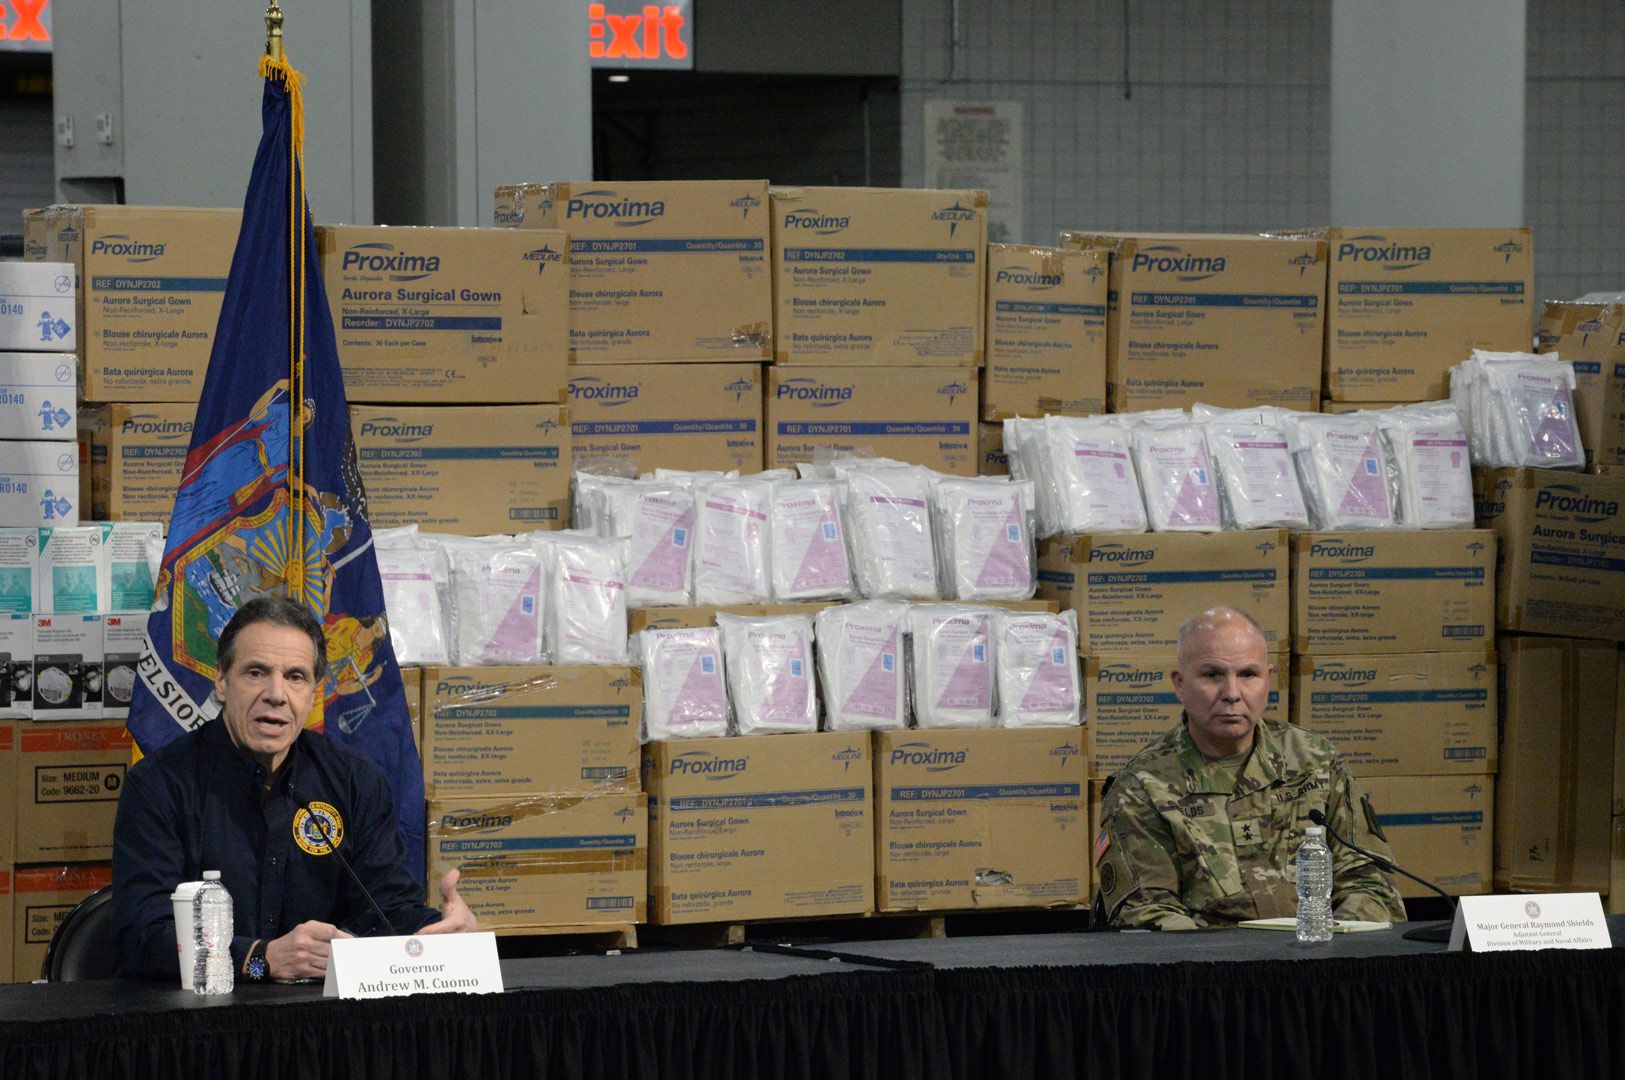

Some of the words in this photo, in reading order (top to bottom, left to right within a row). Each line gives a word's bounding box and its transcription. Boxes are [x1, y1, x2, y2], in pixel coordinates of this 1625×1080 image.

[567, 199, 665, 218] Proxima
[785, 215, 849, 229] Proxima
[92, 238, 165, 257] Proxima
[1338, 243, 1432, 261] Proxima
[342, 252, 440, 272] Proxima
[522, 253, 562, 262] MEDLINE
[593, 257, 624, 267] Surgical
[1132, 253, 1226, 272] Proxima
[793, 267, 817, 275] Aurora
[997, 271, 1062, 285] Proxima
[342, 288, 392, 301] Aurora
[397, 289, 456, 303] Surgical
[460, 289, 501, 302] Gown
[103, 297, 130, 305] Aurora
[133, 297, 166, 307] Surgical
[169, 297, 191, 306] Gown
[402, 308, 430, 317] X-Large
[344, 319, 381, 328] Reorder:
[386, 319, 434, 328] DYNJP2702
[103, 331, 130, 339] Blouse
[133, 331, 179, 340] chirurgicale
[182, 331, 208, 339] Aurora
[167, 368, 193, 376] Aurora
[1518, 373, 1551, 384] Proxima
[569, 383, 639, 399] Proxima
[777, 384, 853, 400] Proxima
[123, 420, 193, 434] Proxima
[361, 423, 433, 437] Proxima
[590, 444, 619, 452] Surgical
[621, 443, 641, 451] Gown
[1536, 491, 1619, 516] Proxima
[1533, 525, 1575, 540] Aurora
[1089, 549, 1155, 562] Proxima
[1310, 545, 1375, 557] Proxima
[38, 619, 52, 627] 3M
[107, 618, 121, 626] 3M
[846, 622, 882, 633] Proxima
[1098, 669, 1164, 682] Proxima
[1313, 668, 1377, 681] Proxima
[891, 748, 966, 766] Proxima
[670, 757, 747, 775] Proxima
[63, 772, 100, 782] MEDIUM
[63, 784, 100, 795] 9662-20
[890, 810, 914, 818] Aurora
[916, 809, 945, 818] Surgical
[441, 815, 513, 829] Proxima
[670, 821, 694, 829] Aurora
[697, 818, 726, 828] Surgical
[729, 817, 749, 825] Gown
[670, 853, 694, 861] Blouse
[741, 849, 765, 857] Aurora
[728, 889, 752, 897] Aurora
[1531, 921, 1566, 929] Raymond
[1567, 919, 1594, 927] Shields
[390, 963, 445, 975] Governor
[358, 981, 410, 993] Andrew
[414, 979, 429, 990] M.
[432, 977, 479, 989] Cuomo
